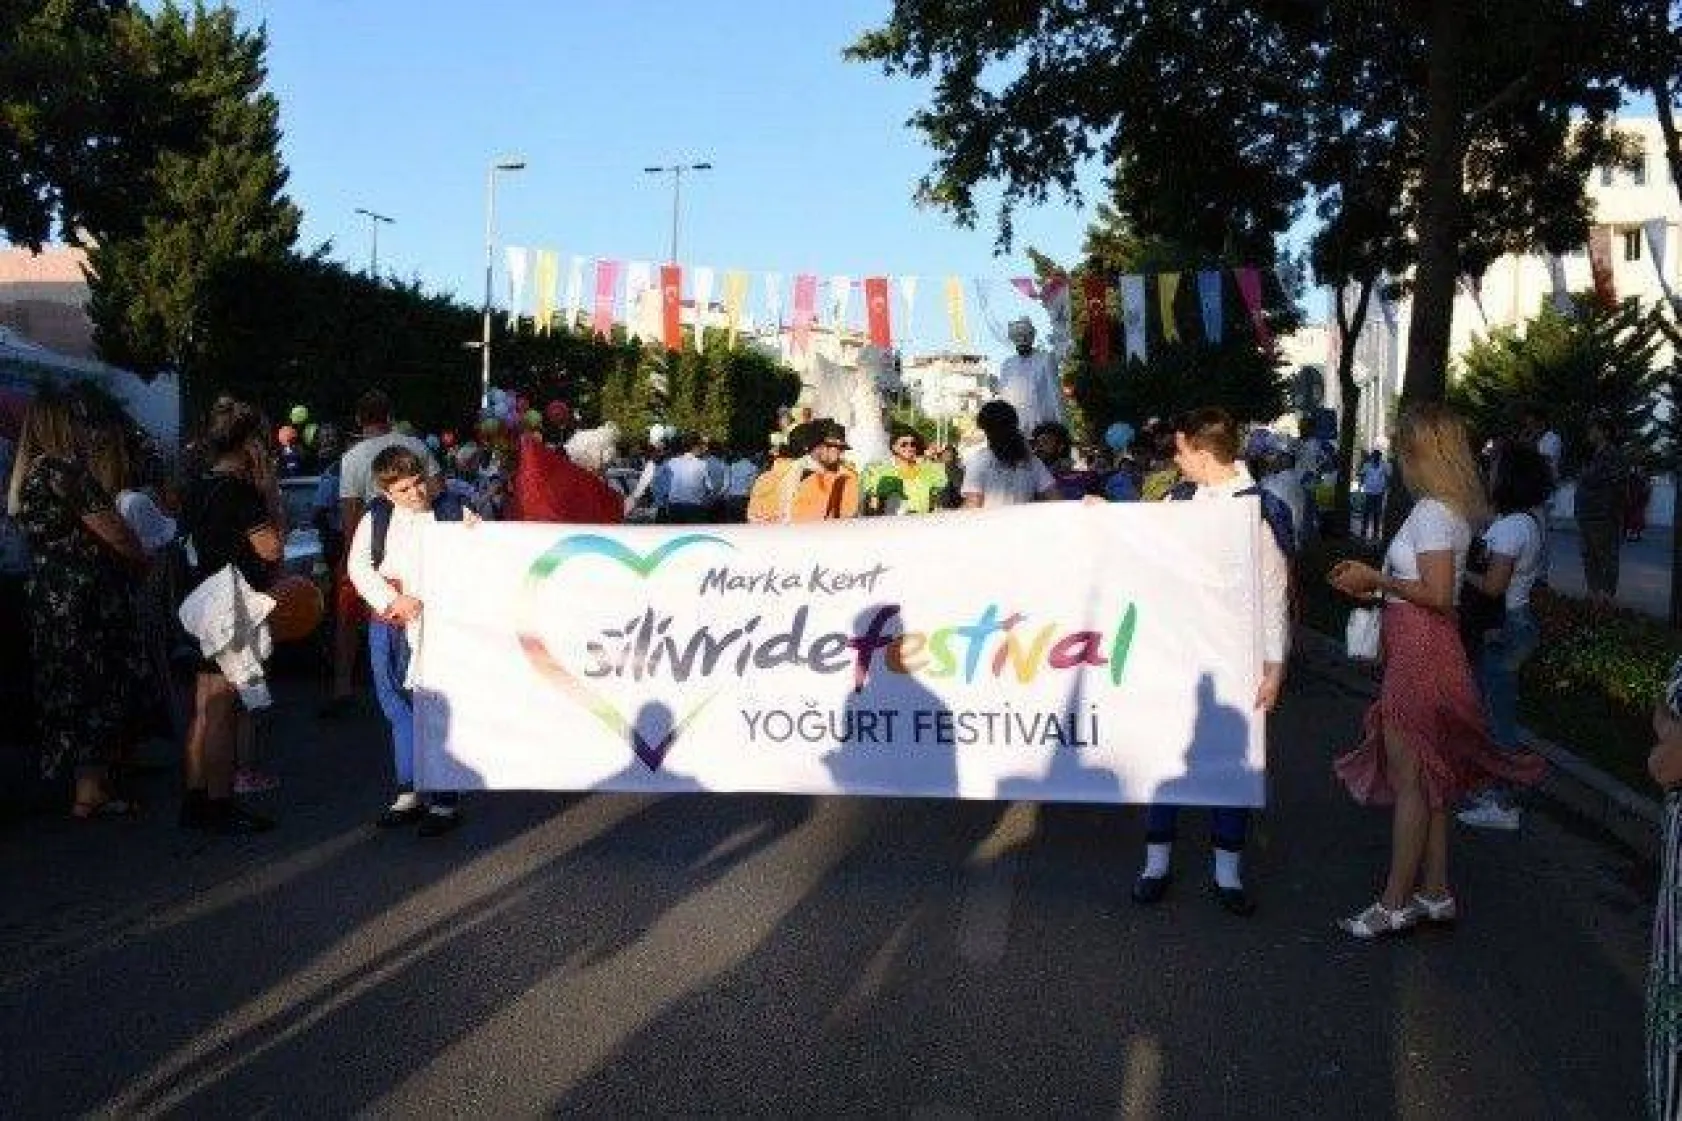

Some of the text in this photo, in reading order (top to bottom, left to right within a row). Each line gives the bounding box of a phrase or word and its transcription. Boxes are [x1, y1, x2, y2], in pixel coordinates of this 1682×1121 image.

[700, 562, 892, 596] Marka Kent
[741, 700, 899, 744] YOĞURT
